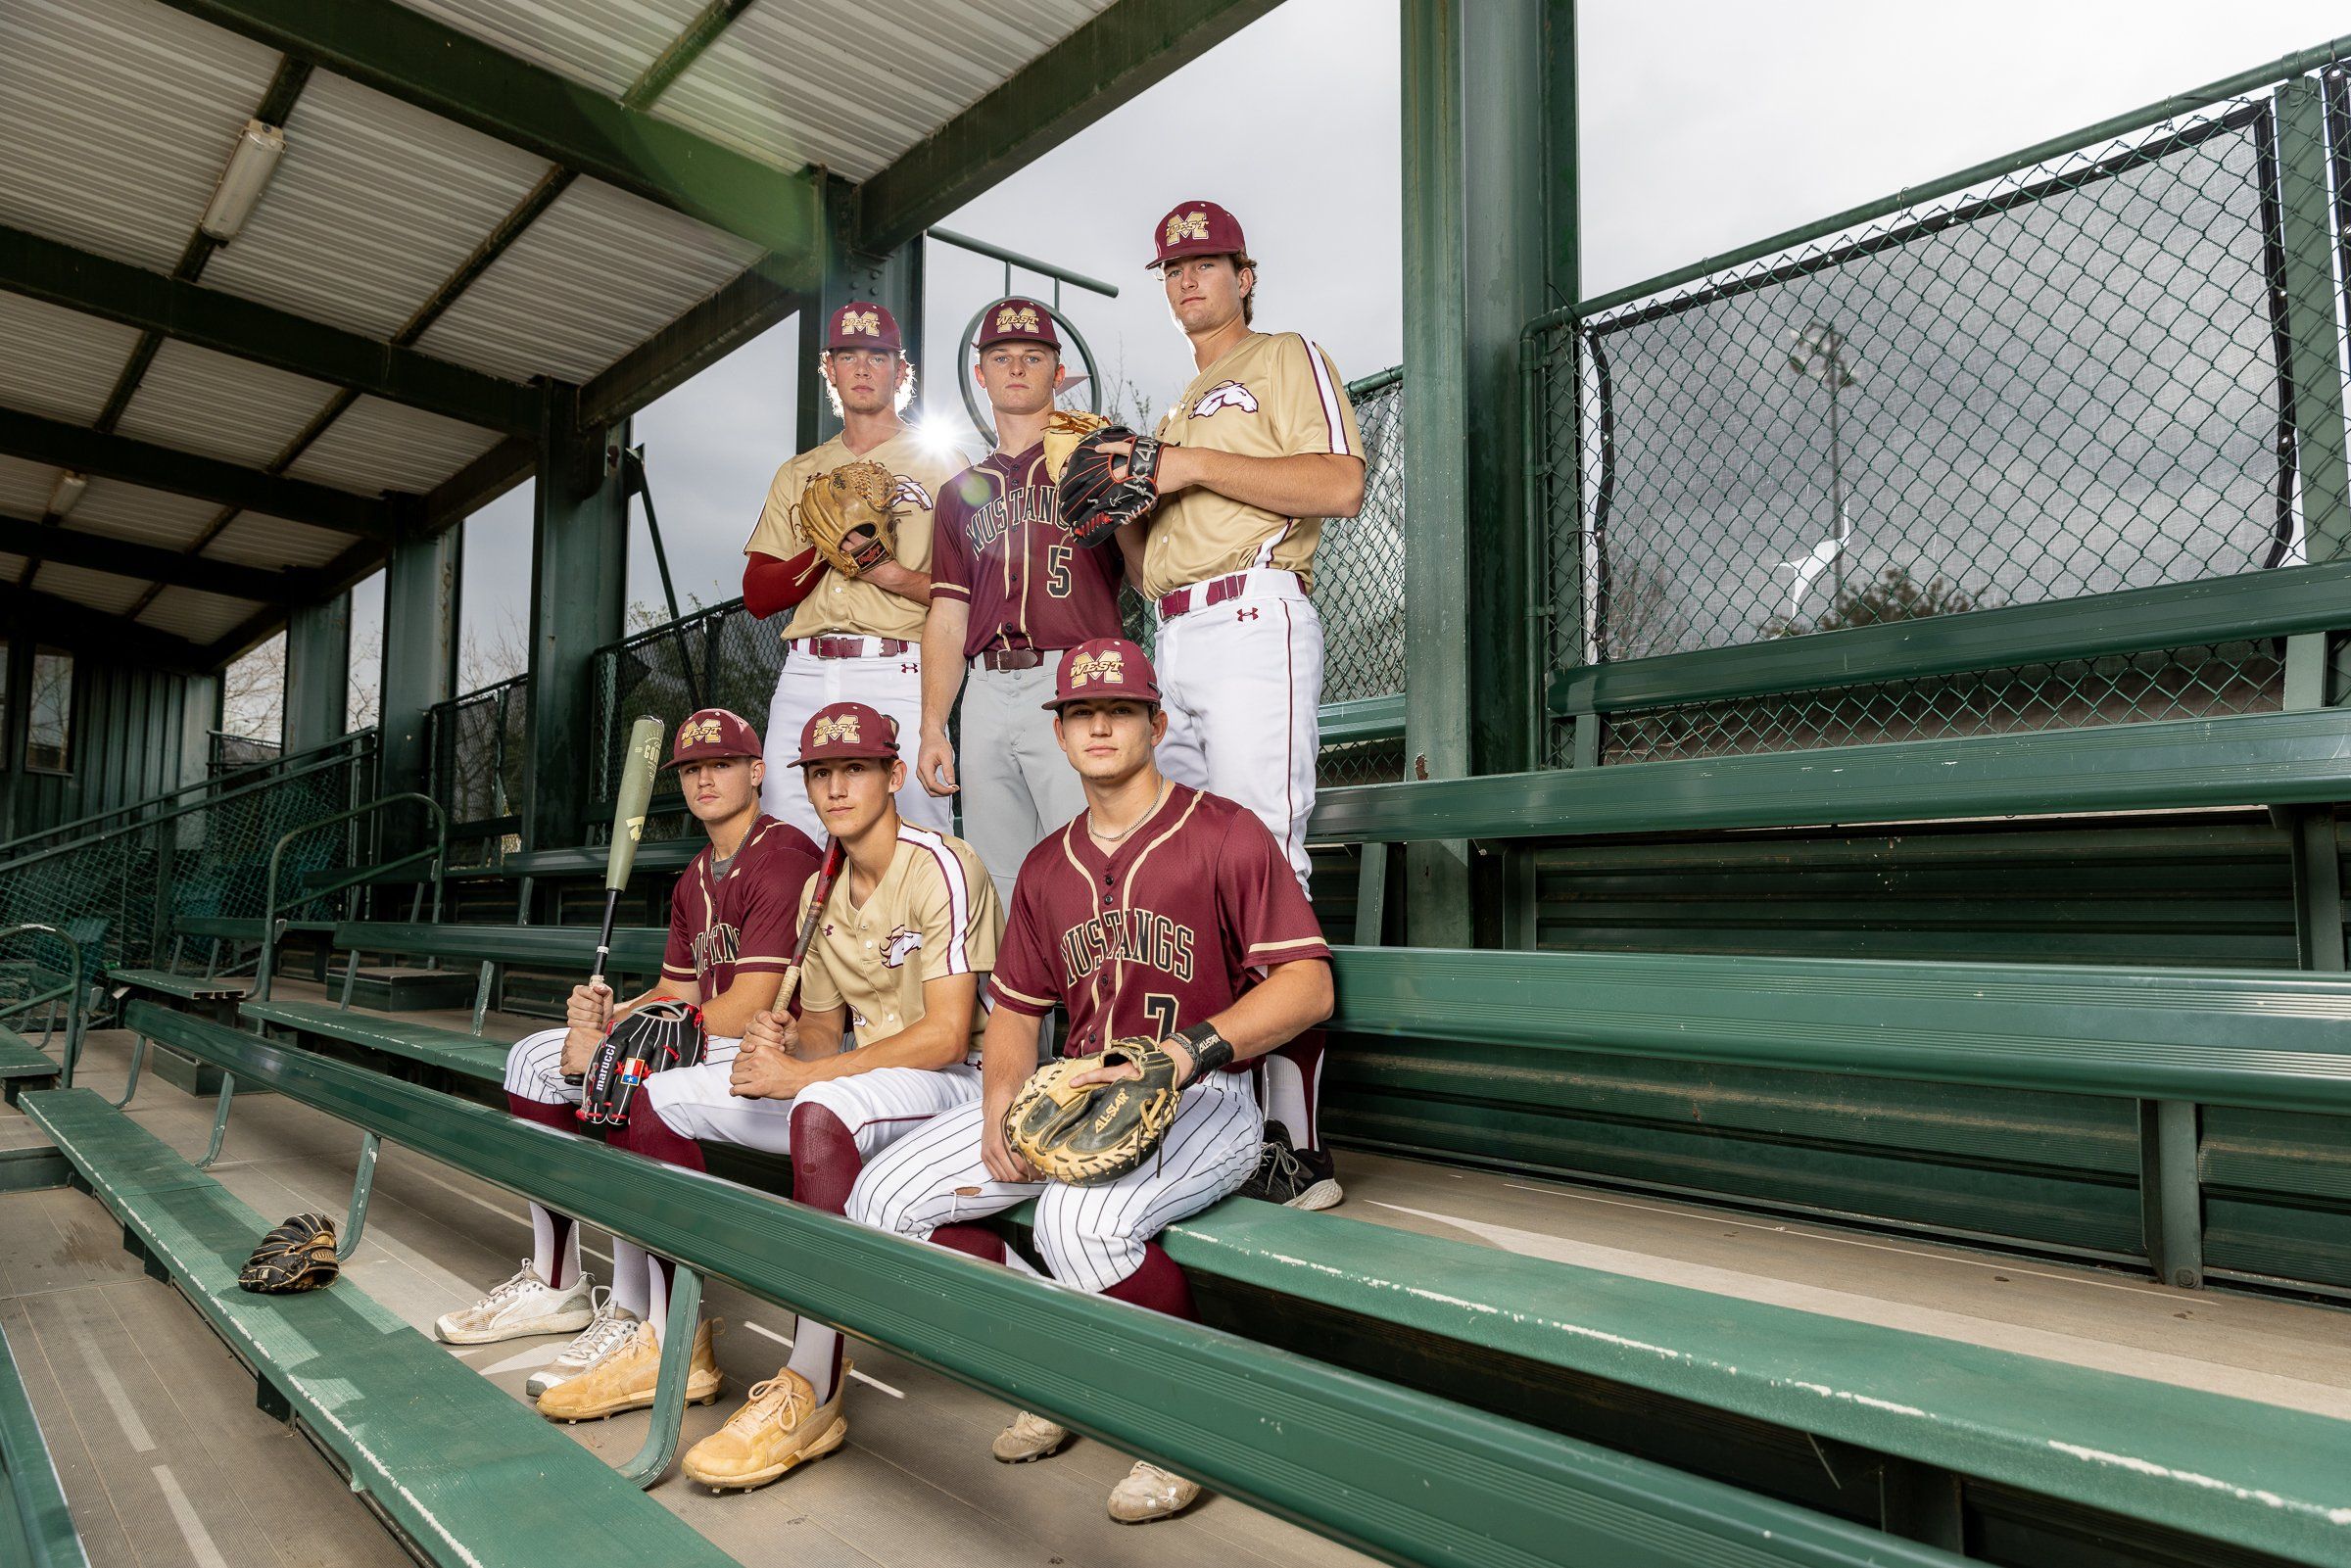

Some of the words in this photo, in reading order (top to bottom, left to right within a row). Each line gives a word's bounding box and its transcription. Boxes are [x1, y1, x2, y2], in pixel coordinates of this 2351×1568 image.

[996, 314, 1039, 327] WEST
[1046, 545, 1073, 597] 5
[1070, 661, 1126, 678] WEST
[681, 727, 722, 741] WEST
[812, 725, 861, 738] WEST
[1144, 992, 1179, 1048] 7
[596, 1043, 616, 1092] marucci
